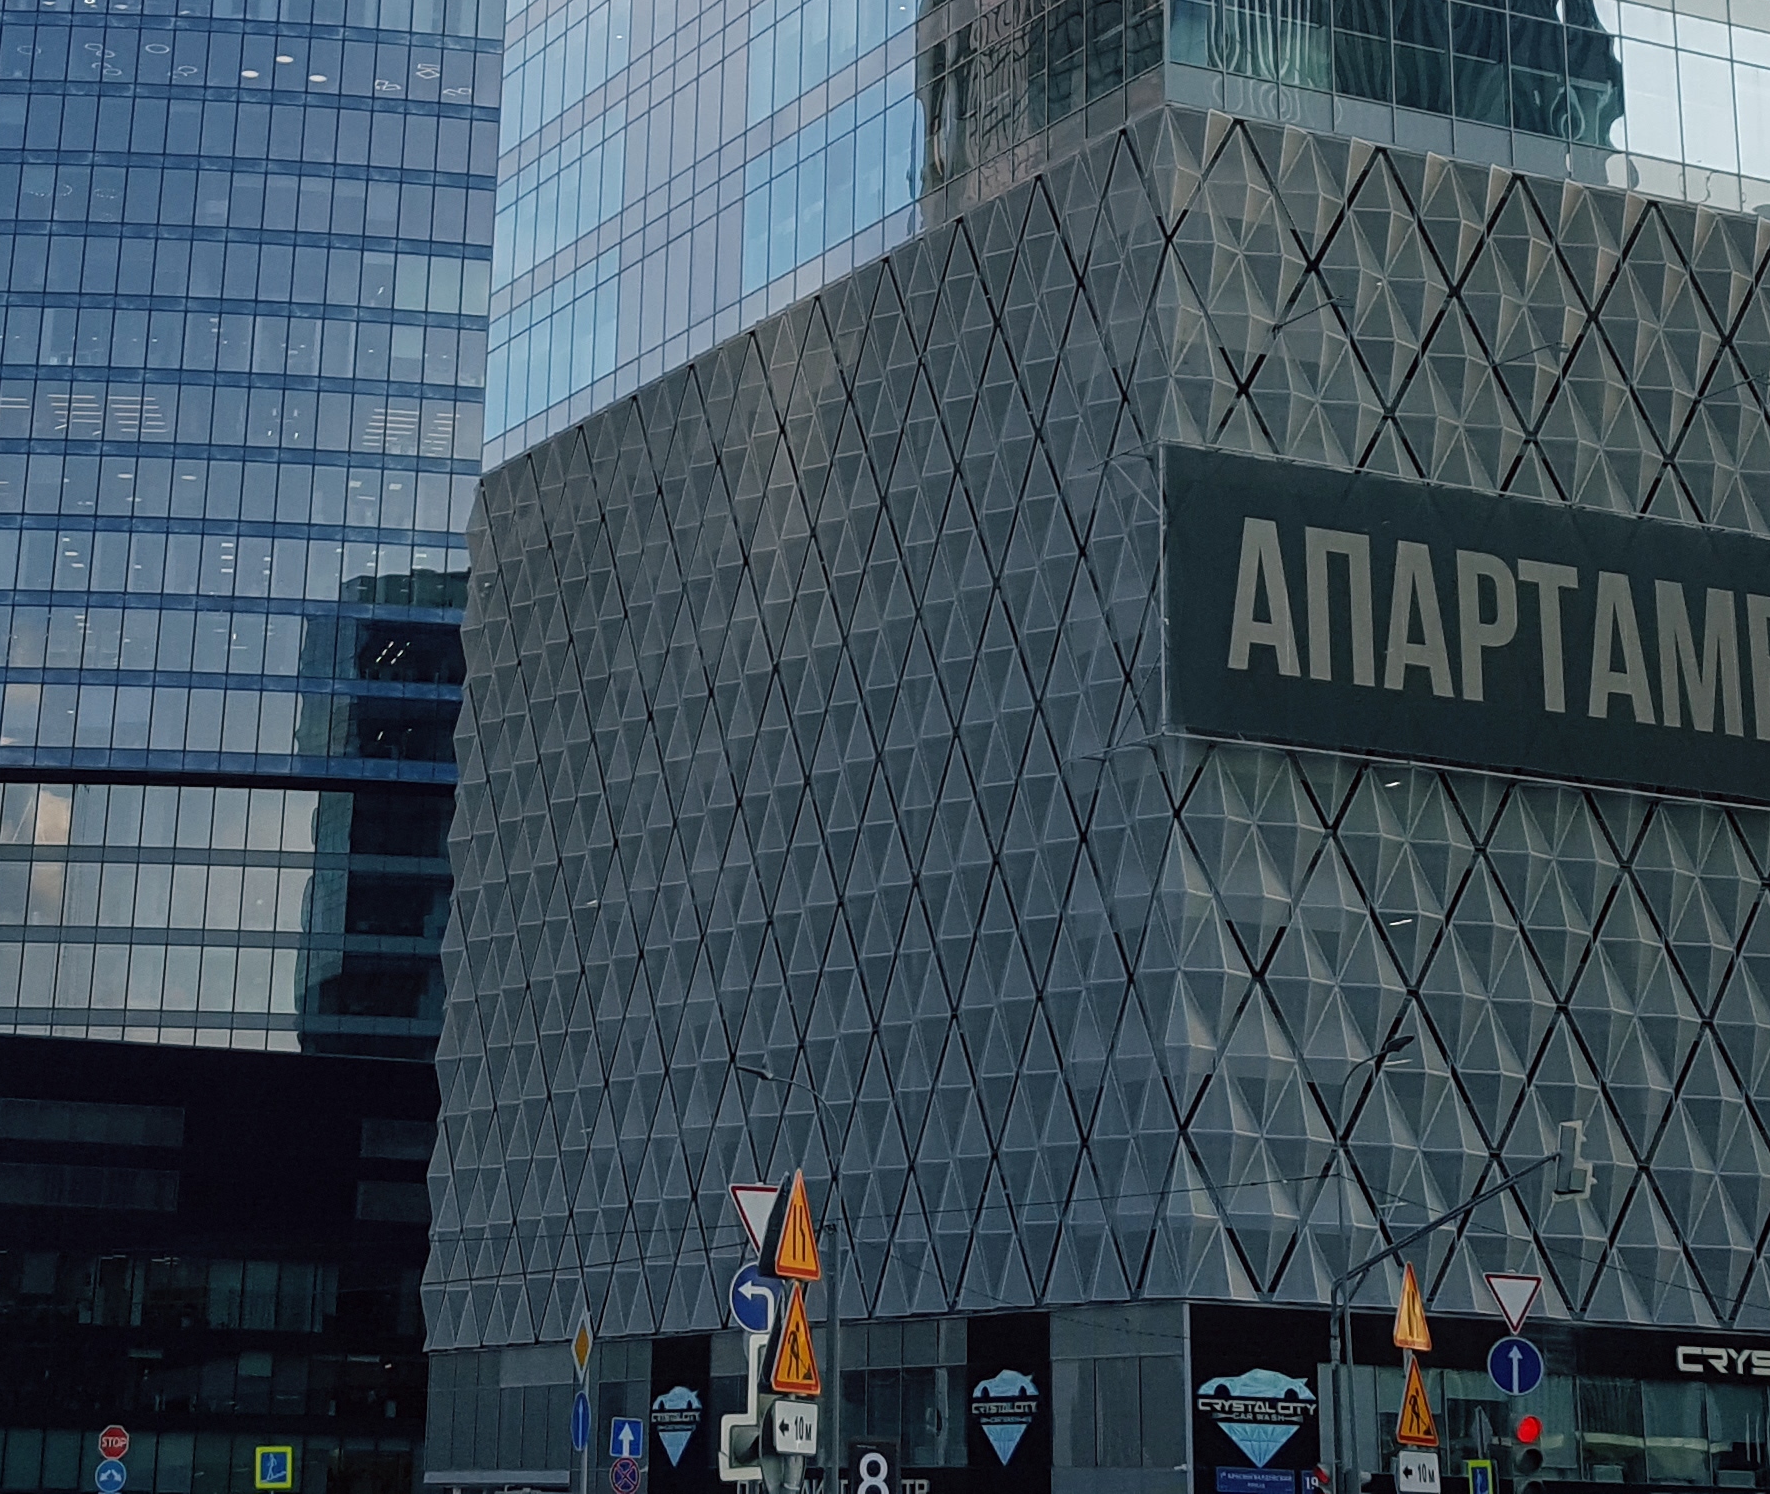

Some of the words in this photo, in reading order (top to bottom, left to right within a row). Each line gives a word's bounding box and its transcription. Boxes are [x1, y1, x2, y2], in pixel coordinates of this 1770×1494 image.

[1233, 1412, 1253, 1421] CAR
[1256, 1413, 1285, 1422] WASH
[101, 1436, 127, 1448] STOP
